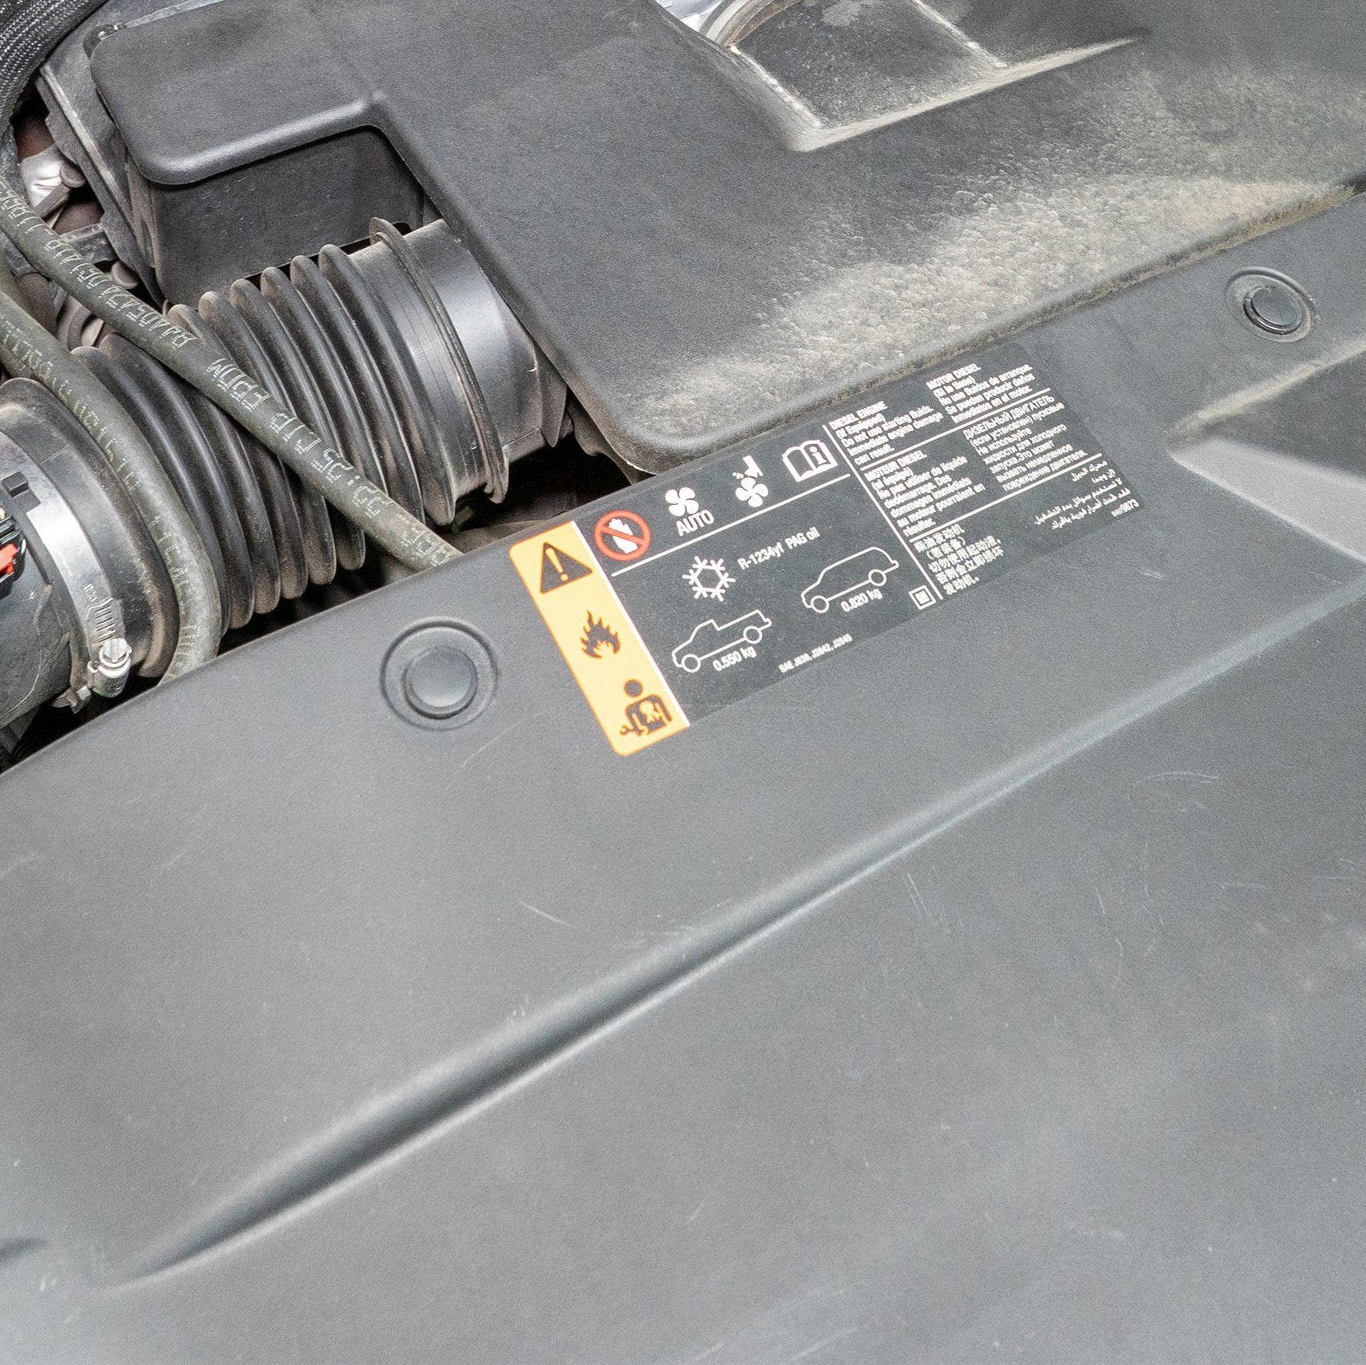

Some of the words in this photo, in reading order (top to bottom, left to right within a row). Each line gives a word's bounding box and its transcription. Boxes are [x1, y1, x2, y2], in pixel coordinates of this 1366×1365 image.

[204, 357, 268, 411] EPDM
[926, 373, 955, 389] MOTOR
[952, 363, 981, 378] DIESEL
[828, 413, 858, 429] DIESEL
[856, 401, 887, 418] ENGINE
[887, 424, 913, 439] engine
[912, 412, 943, 428] damage
[963, 411, 1011, 439] ДИЗЕЛЬНЫЙ
[1010, 395, 1054, 419] ДВИГАТЕЛЬ
[840, 437, 854, 447] Do
[853, 431, 868, 442] not
[866, 426, 882, 437] use
[881, 414, 911, 430] starting
[864, 461, 899, 481] MOTEUR
[897, 450, 926, 466] DIESEL
[676, 509, 715, 537] AUTO
[737, 540, 785, 571] R-1234yf
[785, 532, 808, 549] PAG
[804, 527, 821, 542] oil
[866, 588, 884, 607] kg
[712, 649, 743, 673] 0.550
[739, 645, 758, 665] kg
[778, 659, 795, 674] SAE
